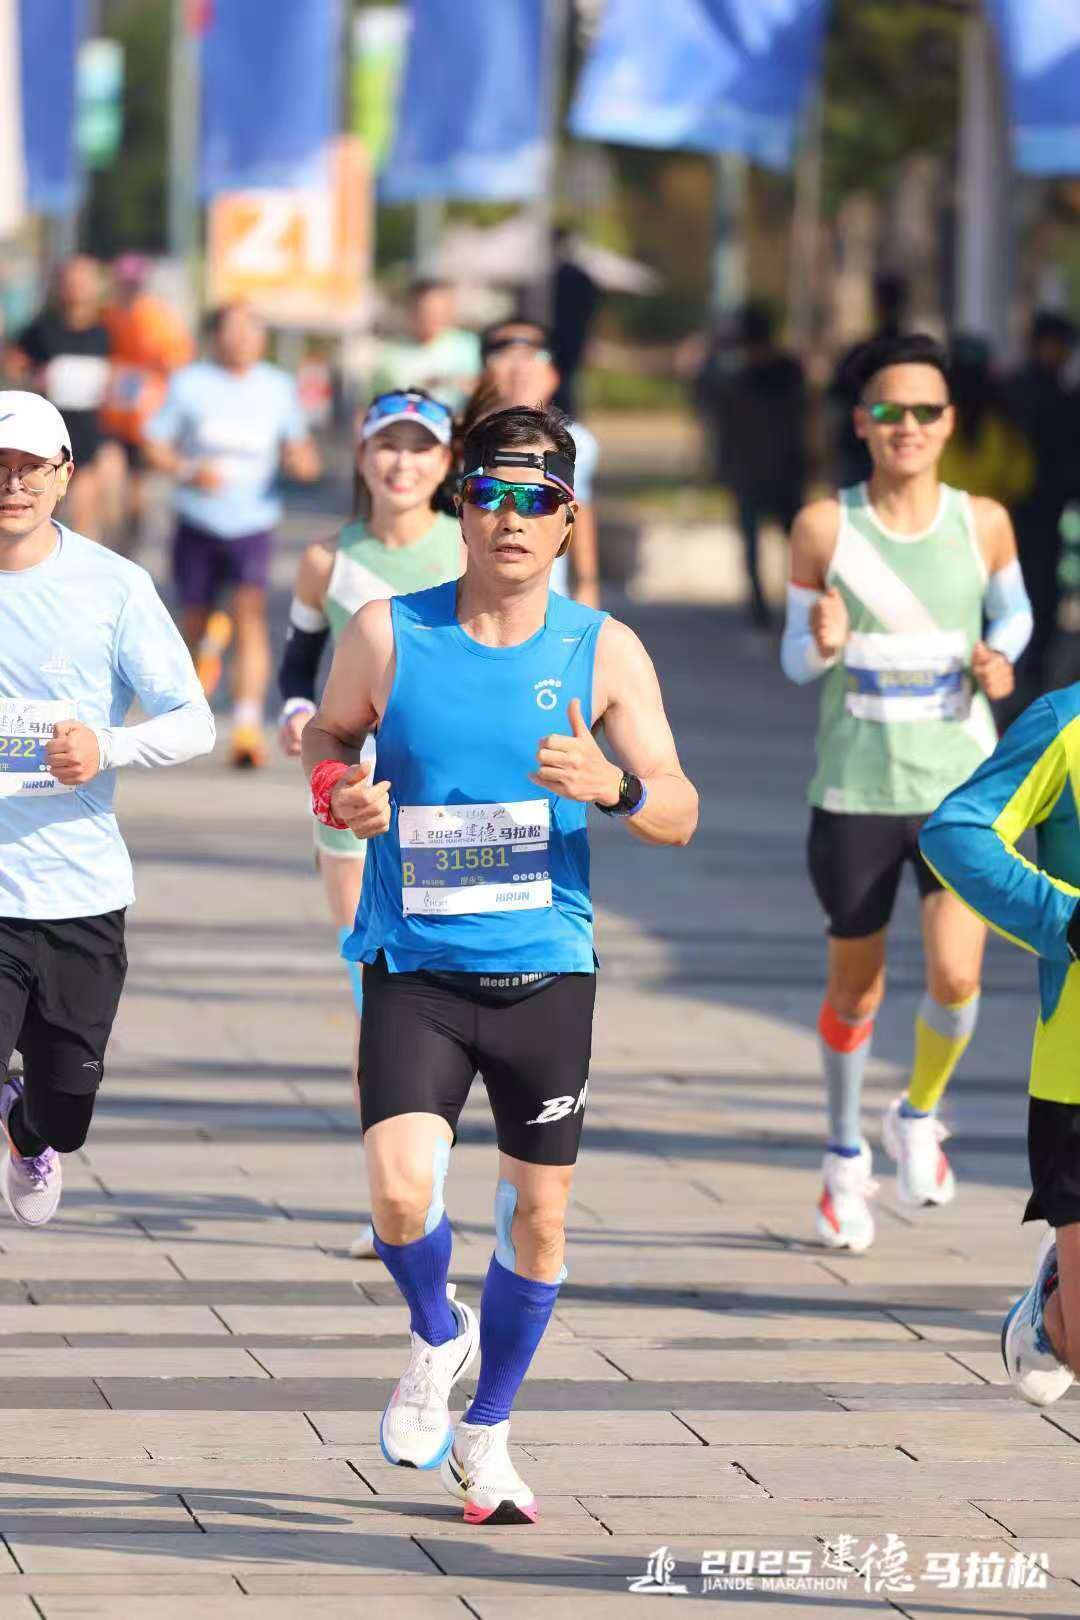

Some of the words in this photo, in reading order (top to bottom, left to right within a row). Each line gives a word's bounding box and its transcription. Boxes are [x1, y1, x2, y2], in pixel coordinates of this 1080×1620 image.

[427, 829, 463, 839] 2025
[435, 846, 510, 871] 31581
[402, 862, 416, 887] B
[480, 976, 510, 987] Meet
